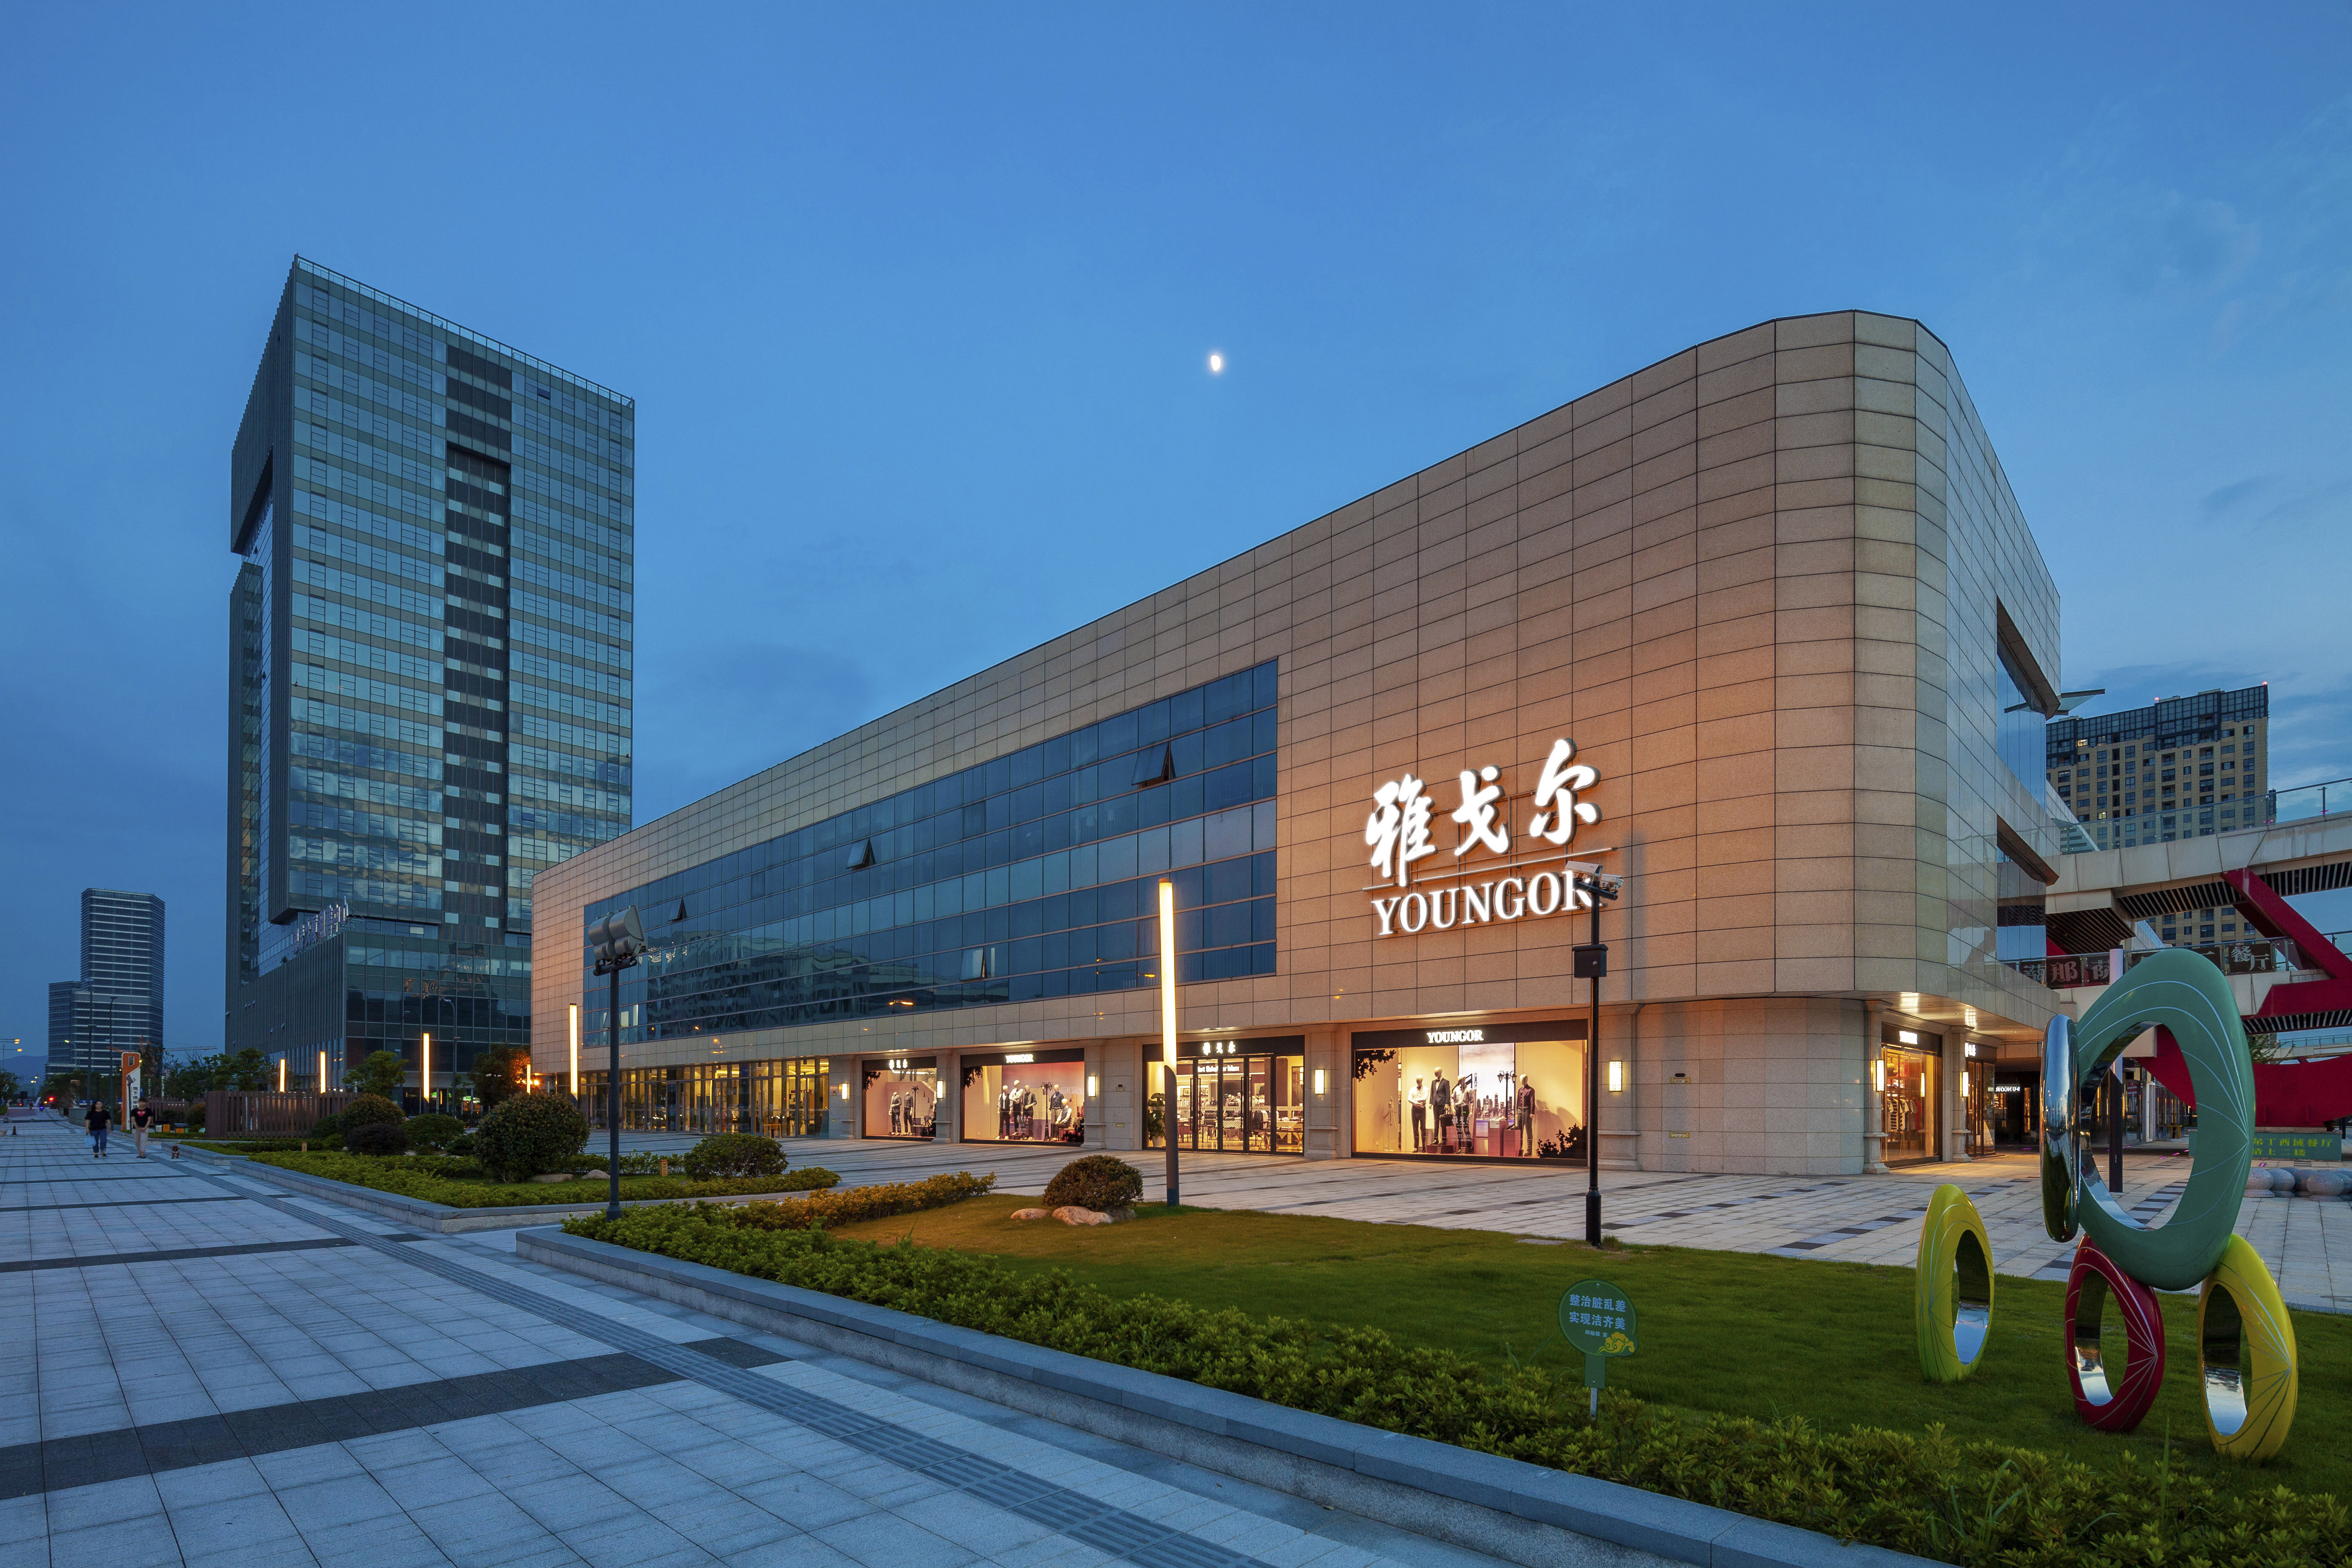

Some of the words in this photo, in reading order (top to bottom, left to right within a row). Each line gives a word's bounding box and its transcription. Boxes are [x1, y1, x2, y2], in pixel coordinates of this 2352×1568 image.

[1366, 738, 1601, 886] 雅戈尔
[2231, 945, 2269, 971] 餐厅
[1427, 1030, 1484, 1043] YOUNGOR
[1569, 1294, 1626, 1312] 整治脏乱差
[1569, 1311, 1625, 1330] 实现洁齐美
